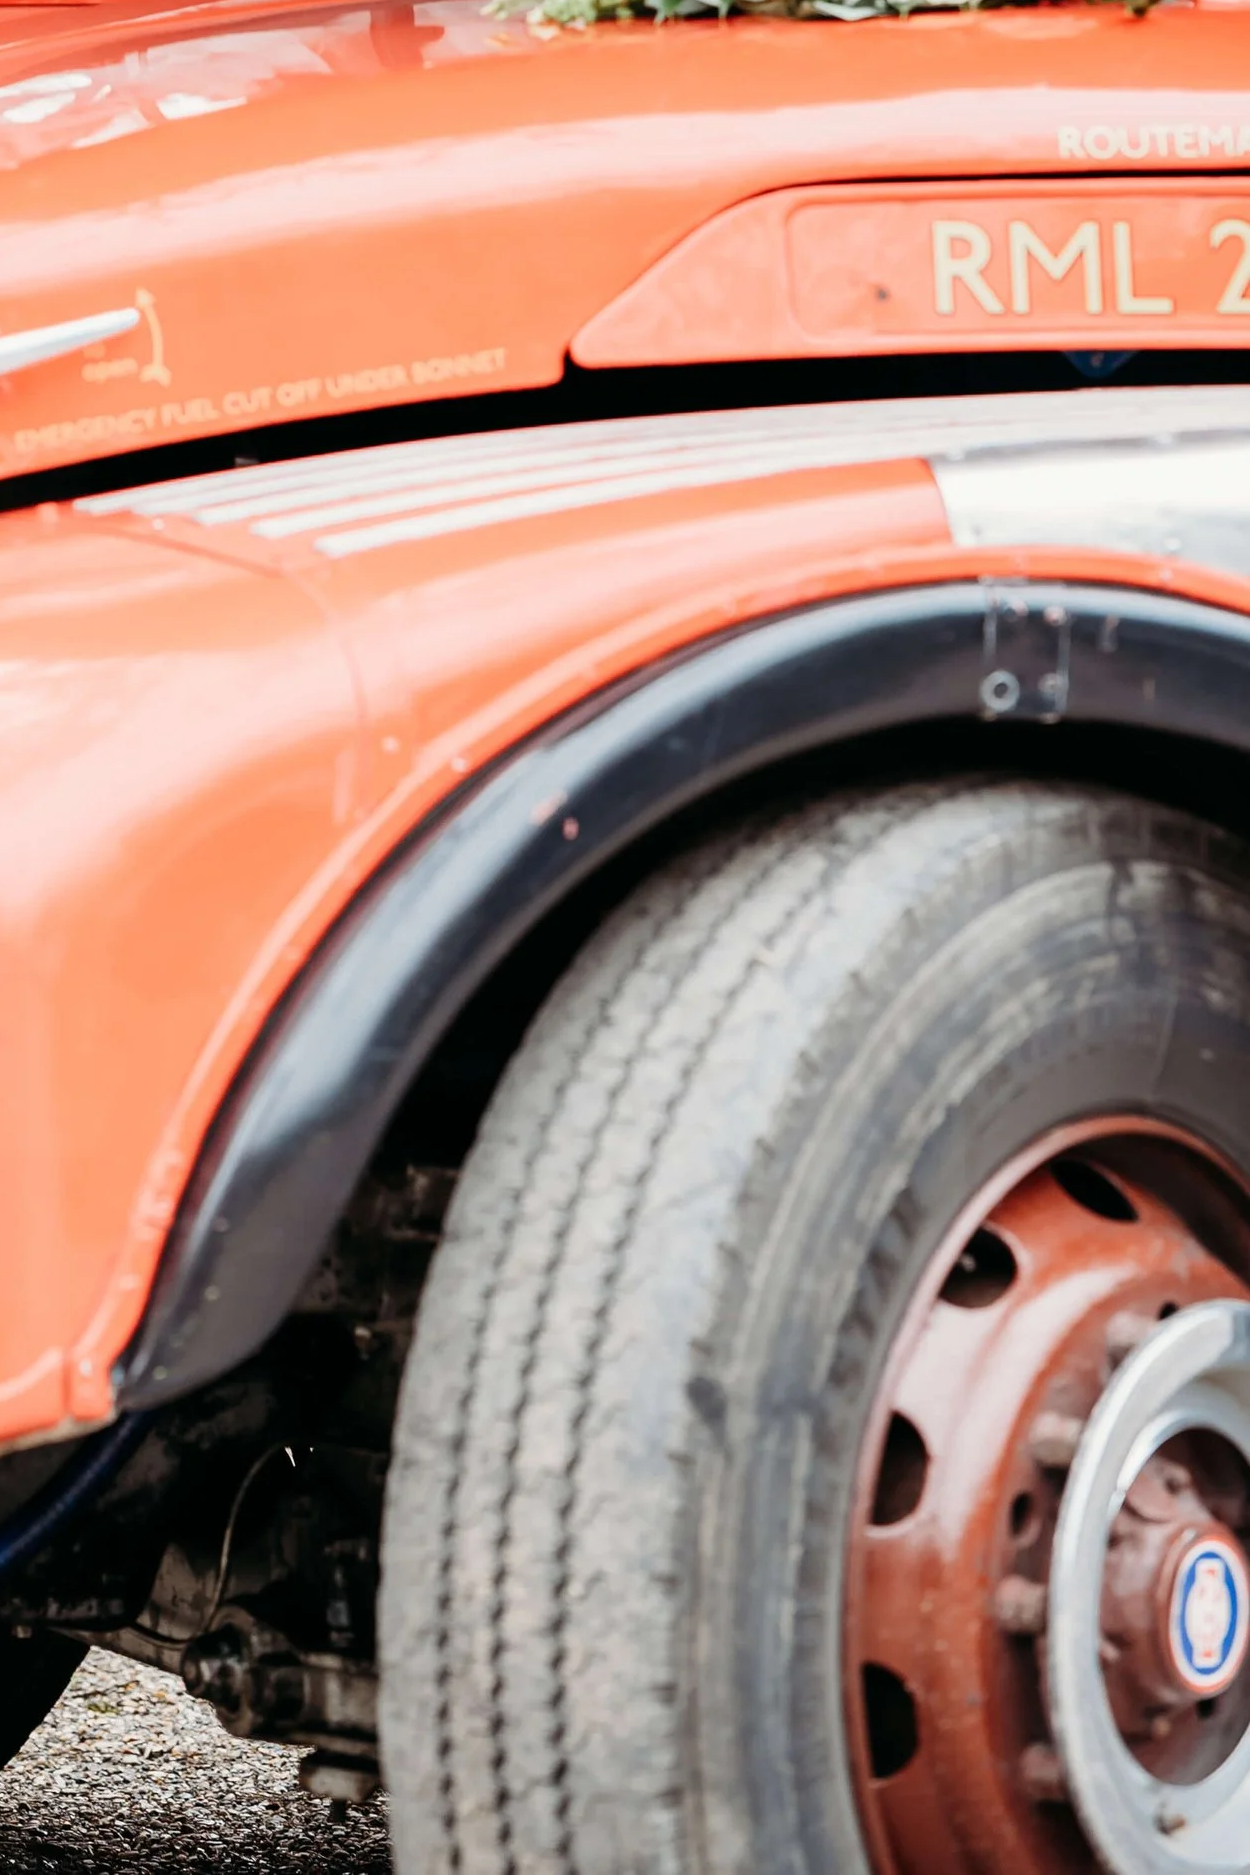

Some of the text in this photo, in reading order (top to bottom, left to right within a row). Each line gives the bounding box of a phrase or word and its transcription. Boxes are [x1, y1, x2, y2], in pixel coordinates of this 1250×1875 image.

[931, 219, 1250, 315] RML 2
[222, 386, 273, 416] CUT
[276, 377, 323, 407] OFF
[324, 363, 409, 398] UNDER
